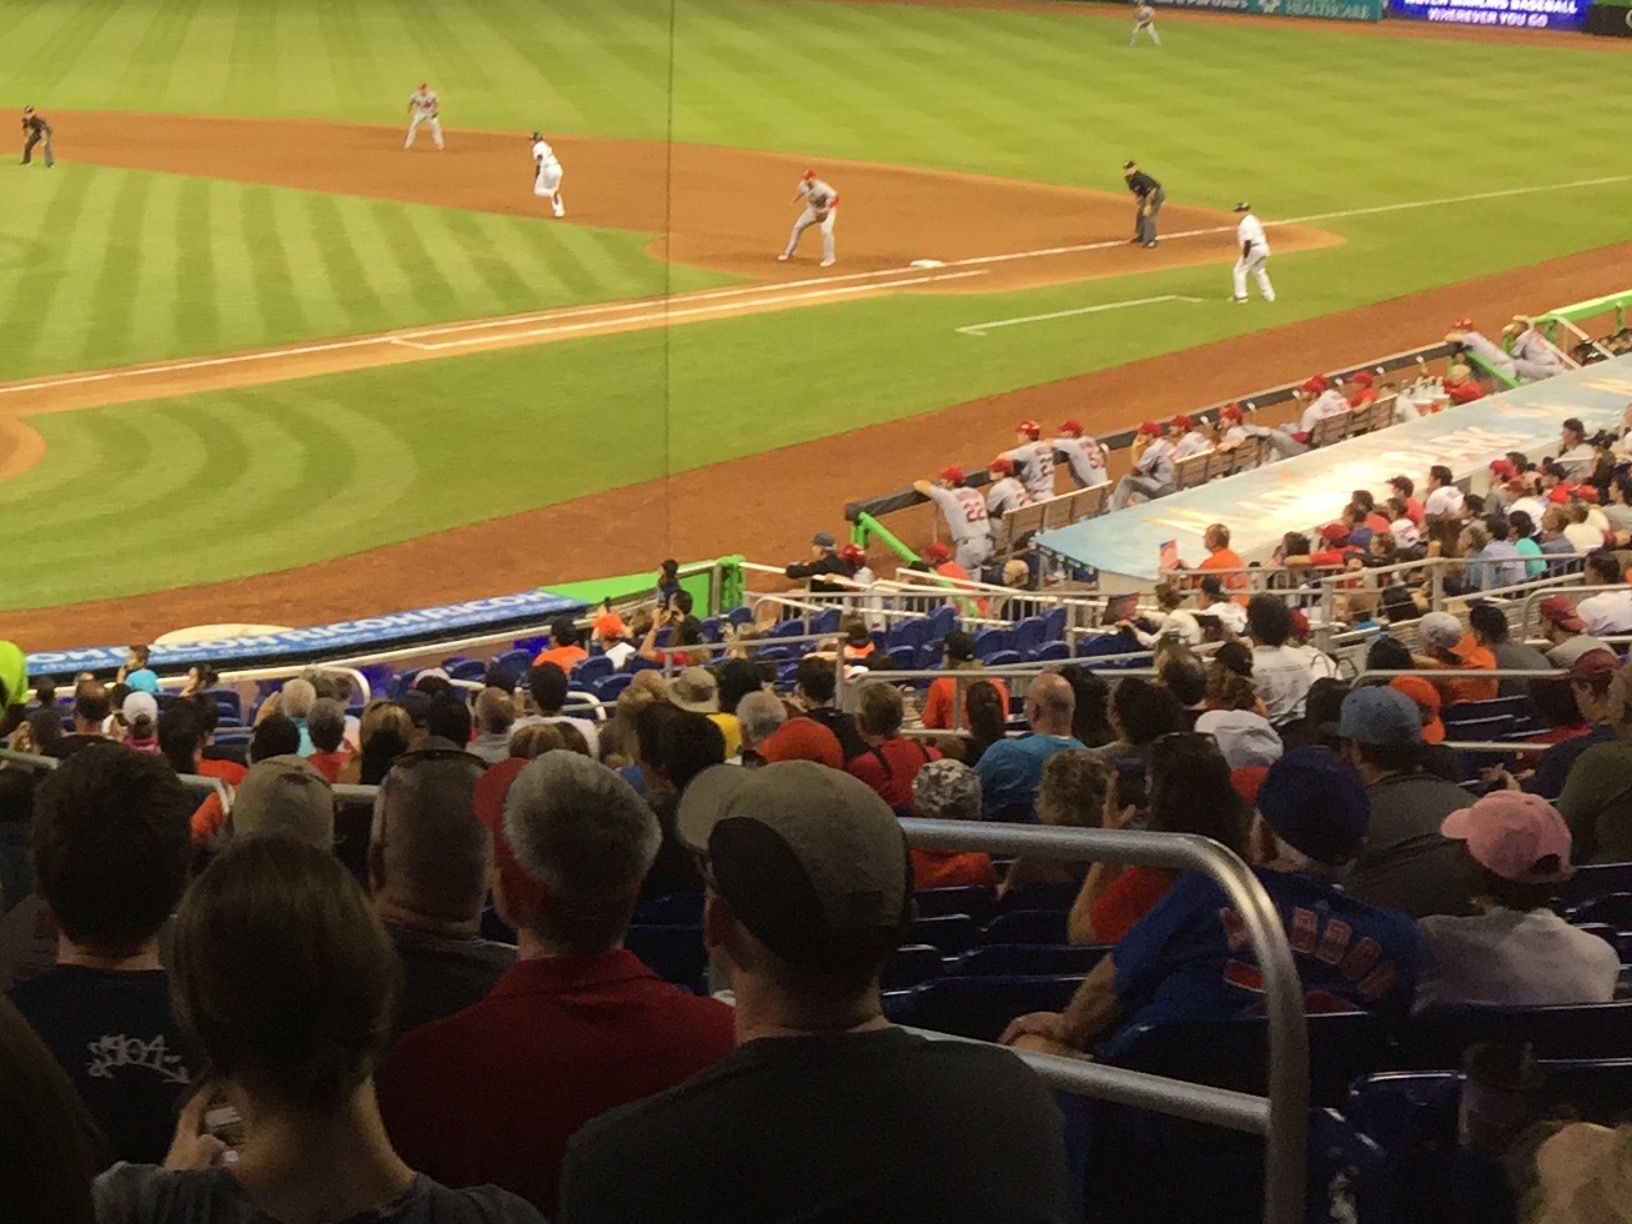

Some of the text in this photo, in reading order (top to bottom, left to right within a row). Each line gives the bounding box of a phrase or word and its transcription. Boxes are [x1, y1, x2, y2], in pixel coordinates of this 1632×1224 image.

[1428, 8, 1548, 28] WHEREVER YOU GO
[419, 590, 560, 623] RICOH
[282, 611, 421, 642] RICOH
